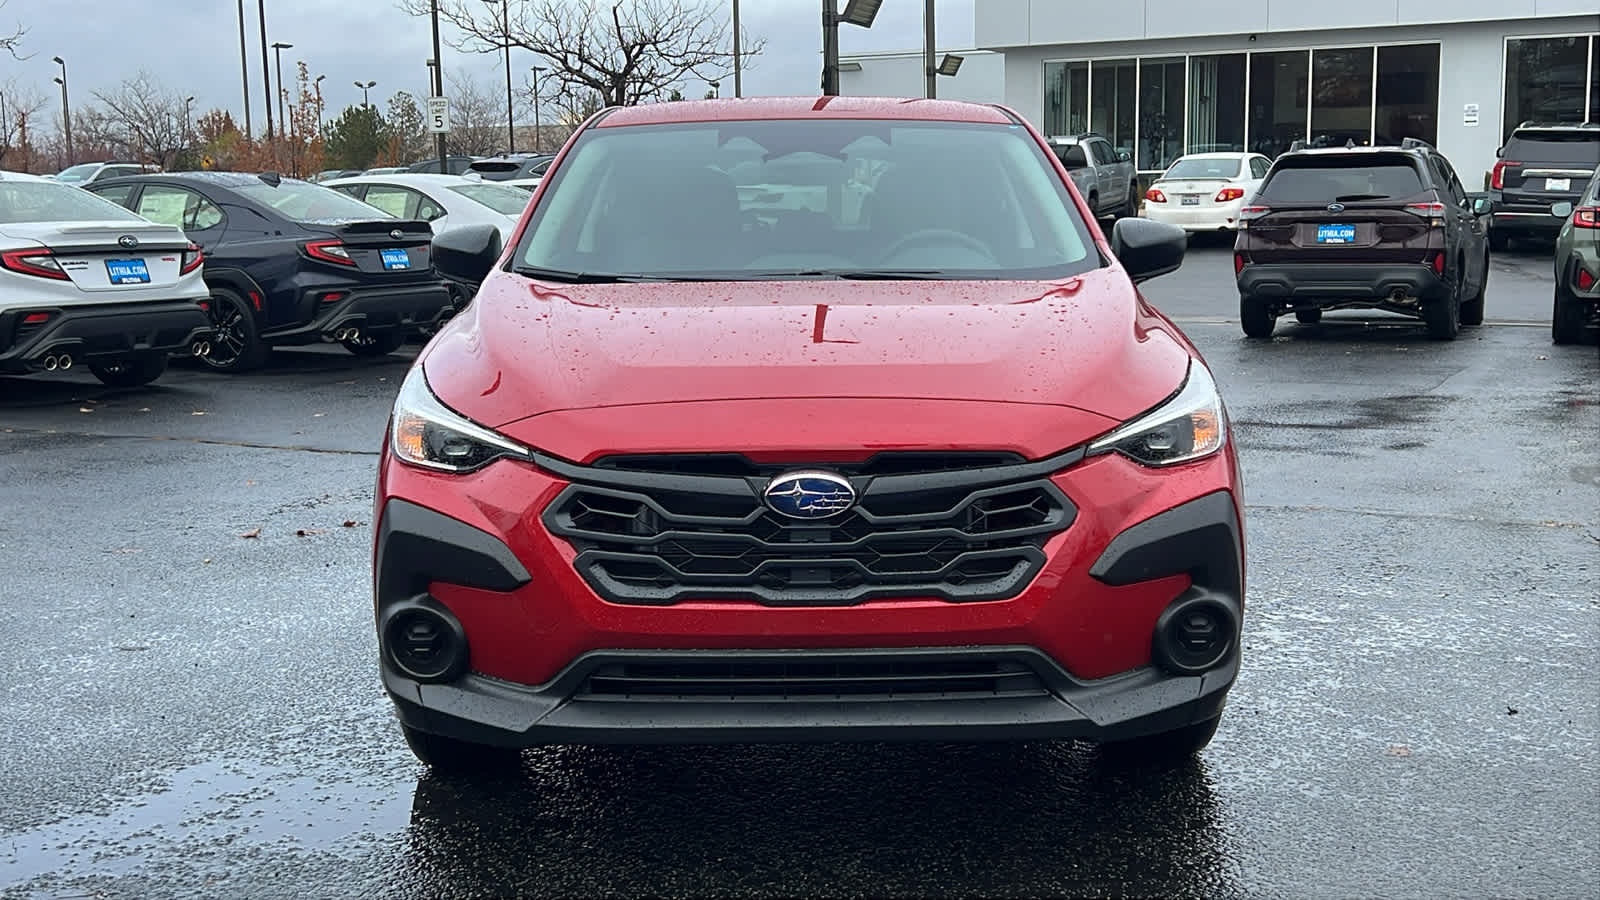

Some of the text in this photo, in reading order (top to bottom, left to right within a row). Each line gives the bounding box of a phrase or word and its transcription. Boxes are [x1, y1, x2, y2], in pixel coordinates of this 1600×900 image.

[435, 115, 443, 128] 5
[1318, 229, 1354, 238] LITHIA.COM
[108, 265, 147, 276] LITHIA.COM
